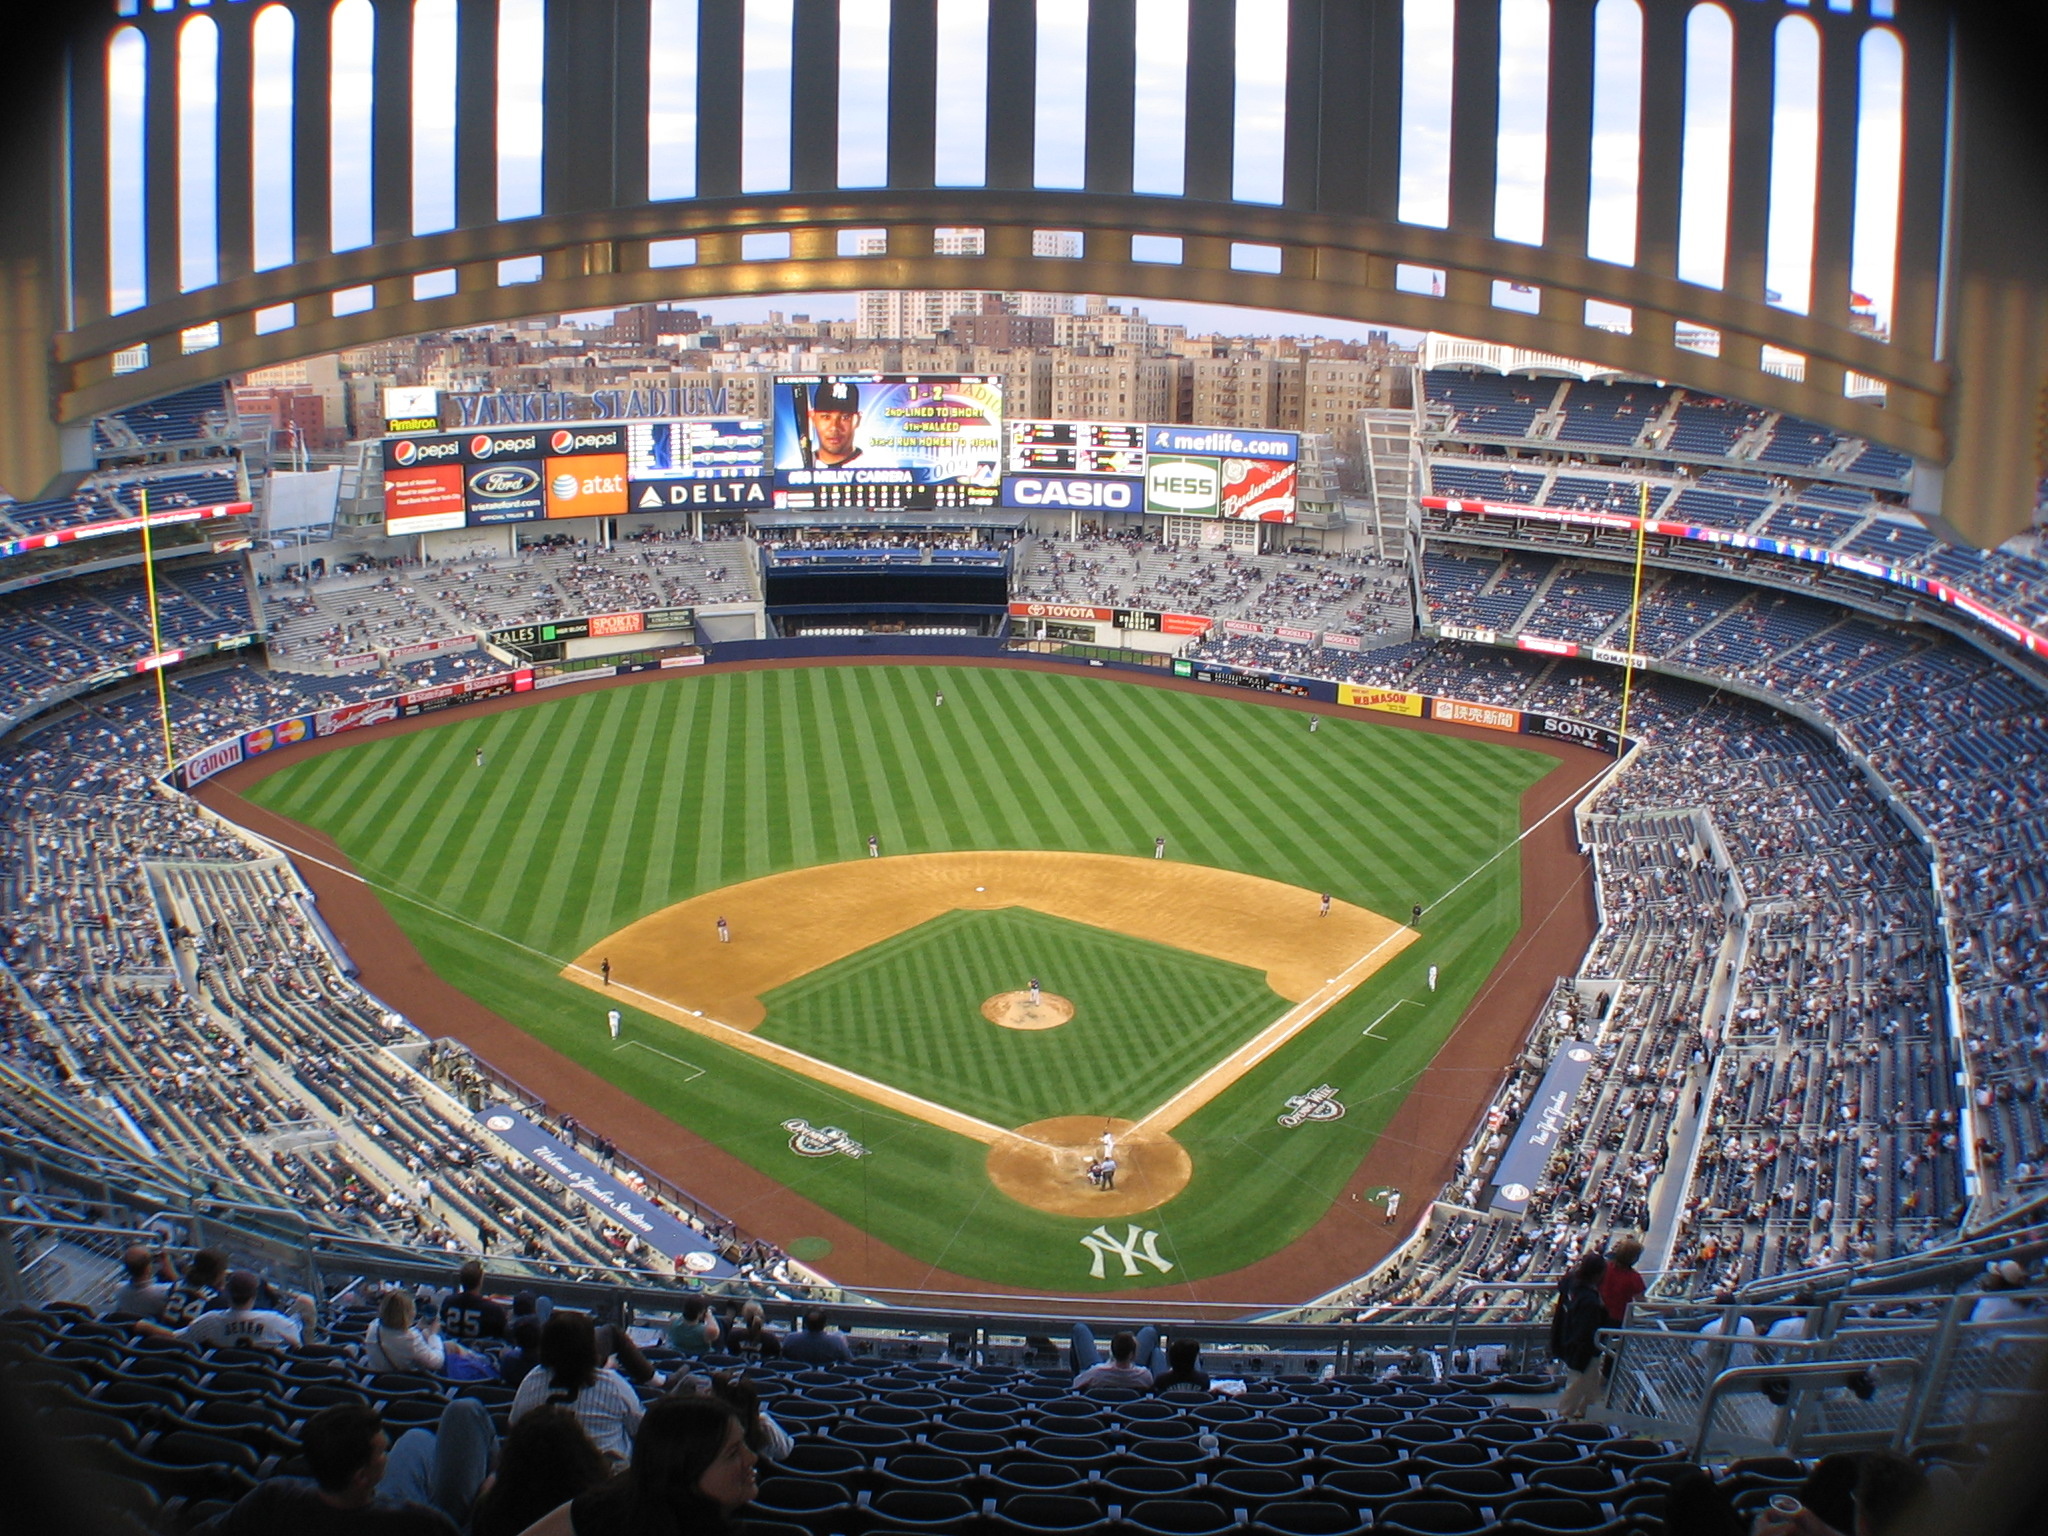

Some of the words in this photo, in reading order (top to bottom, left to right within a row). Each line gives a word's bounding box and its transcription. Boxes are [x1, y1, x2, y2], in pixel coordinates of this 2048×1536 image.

[454, 391, 575, 427] YANKEE
[591, 387, 730, 420] STADIUM
[390, 418, 437, 432] Armitron
[417, 440, 459, 461] pepsi
[494, 435, 536, 454] pepsi
[574, 431, 617, 450] pepsi
[1174, 433, 1289, 456] metlife.com
[485, 473, 524, 491] Ford
[581, 474, 624, 495] at&t
[1153, 477, 1213, 495] HESS
[1221, 463, 1296, 517] Budweiser
[670, 483, 766, 505] DELTA
[1014, 480, 1132, 508] CASIO
[593, 614, 640, 629] SPORTS
[1046, 606, 1095, 619] TOYOTA
[493, 628, 535, 645] ZALES
[1458, 629, 1477, 641] UTZ
[1544, 718, 1598, 741] SONY
[189, 745, 239, 780] Canon
[446, 1306, 480, 1337] 25
